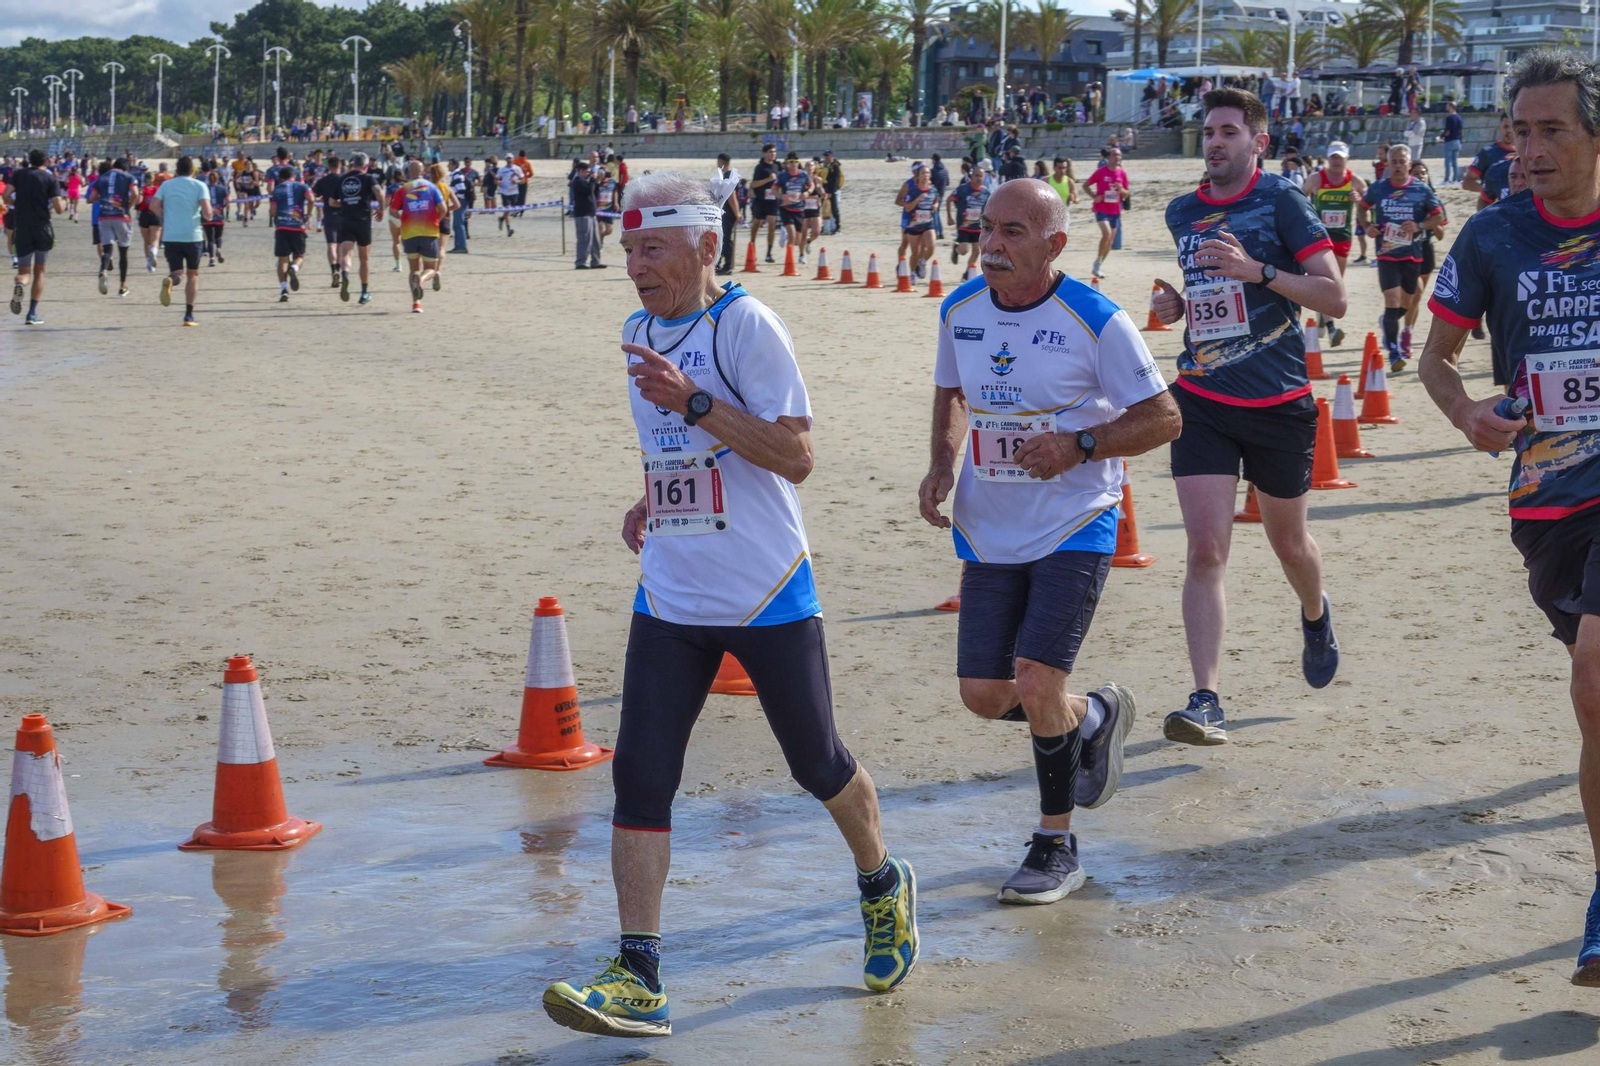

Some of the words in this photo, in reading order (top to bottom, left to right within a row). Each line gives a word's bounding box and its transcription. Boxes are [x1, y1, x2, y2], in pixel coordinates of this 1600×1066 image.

[1195, 300, 1228, 321] 536
[1529, 323, 1569, 337] PRAIA
[1553, 335, 1569, 347] DE
[1041, 343, 1071, 355] seguros
[1568, 357, 1596, 366] CARREIRA
[686, 367, 711, 379] seguros
[981, 384, 1022, 393] ATLETISMO
[1563, 376, 1600, 404] 85
[981, 391, 1022, 402] SAMIL
[654, 477, 696, 506] 161
